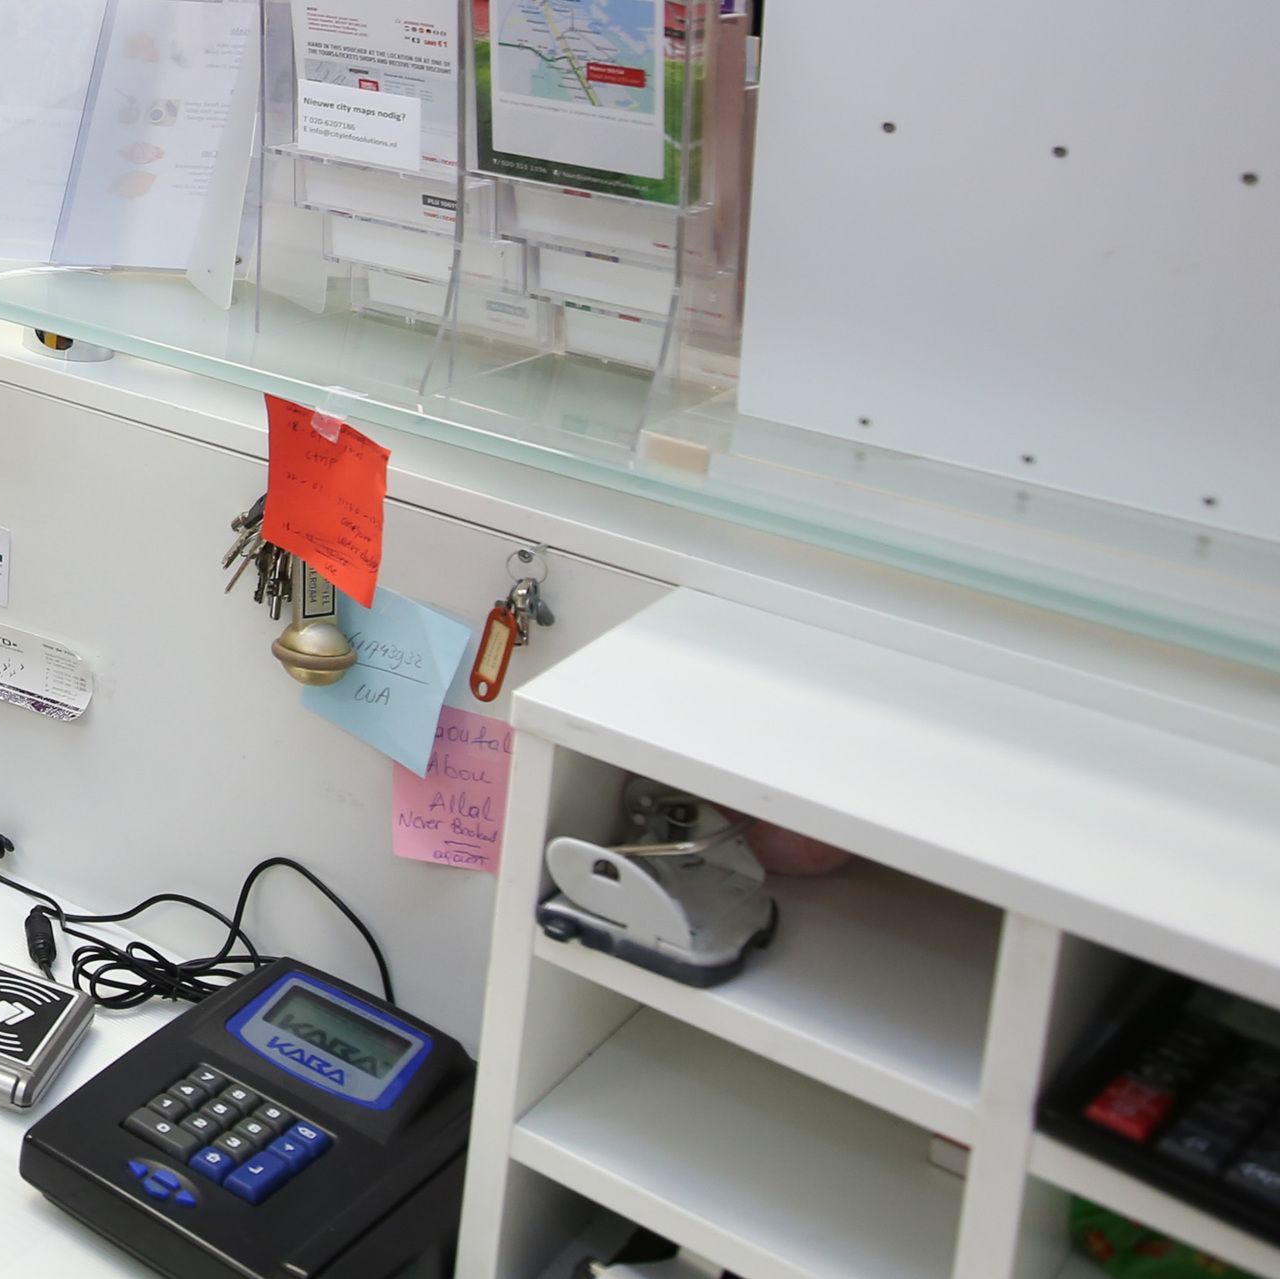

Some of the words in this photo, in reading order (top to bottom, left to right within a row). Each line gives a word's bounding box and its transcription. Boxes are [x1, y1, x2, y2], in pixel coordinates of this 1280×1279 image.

[303, 96, 335, 110] Nieuwe
[336, 101, 352, 113] city
[353, 105, 376, 117] maps
[377, 107, 406, 122] nodig?
[266, 1035, 345, 1087] KABA
[179, 1085, 195, 1095] 4
[212, 1103, 228, 1114] 5
[246, 1123, 263, 1134] 6
[200, 1071, 216, 1082] 7
[231, 1089, 247, 1101] 8
[265, 1108, 281, 1119] 9
[155, 1122, 171, 1134] 0
[161, 1099, 173, 1108] 1
[192, 1118, 208, 1129] 2
[225, 1136, 242, 1148] 3
